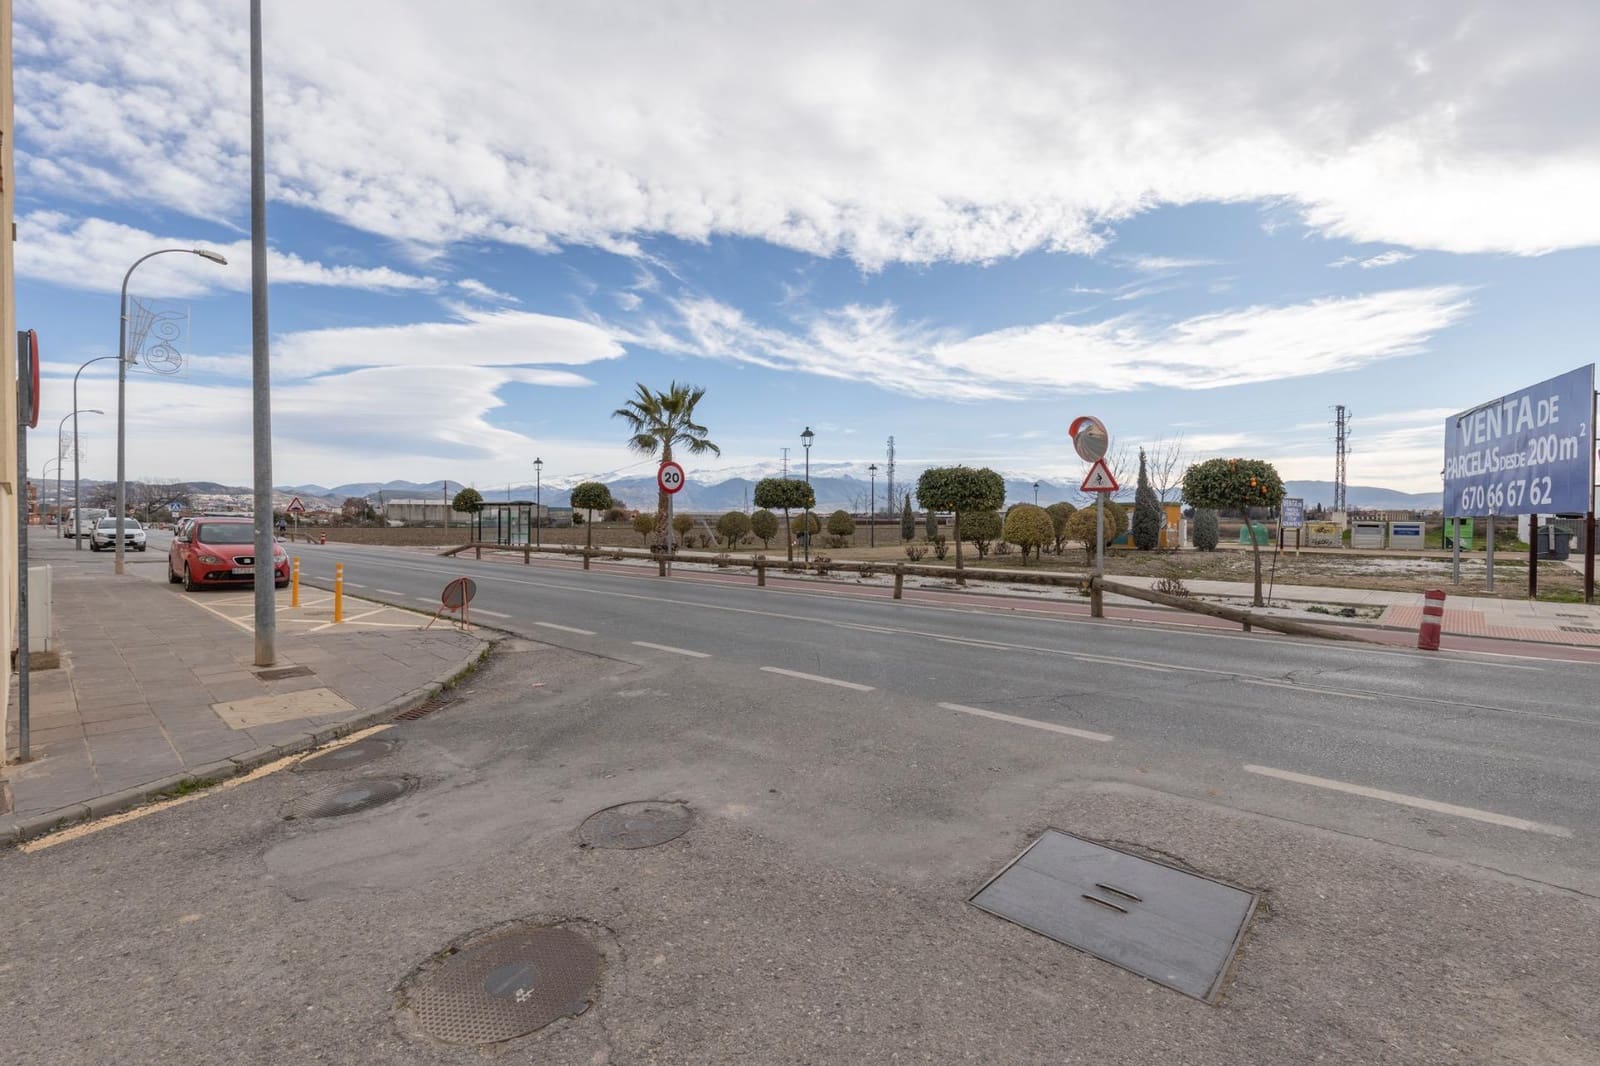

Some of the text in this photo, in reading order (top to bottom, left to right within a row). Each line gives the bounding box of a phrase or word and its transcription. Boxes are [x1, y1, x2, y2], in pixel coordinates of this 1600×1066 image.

[1460, 395, 1559, 447] VENTA DE
[1446, 446, 1500, 480] PARCELAS
[1500, 452, 1526, 471] DESDE
[1527, 434, 1558, 466] 200
[664, 472, 680, 483] 20
[1462, 476, 1552, 510] 670 66 67 62
